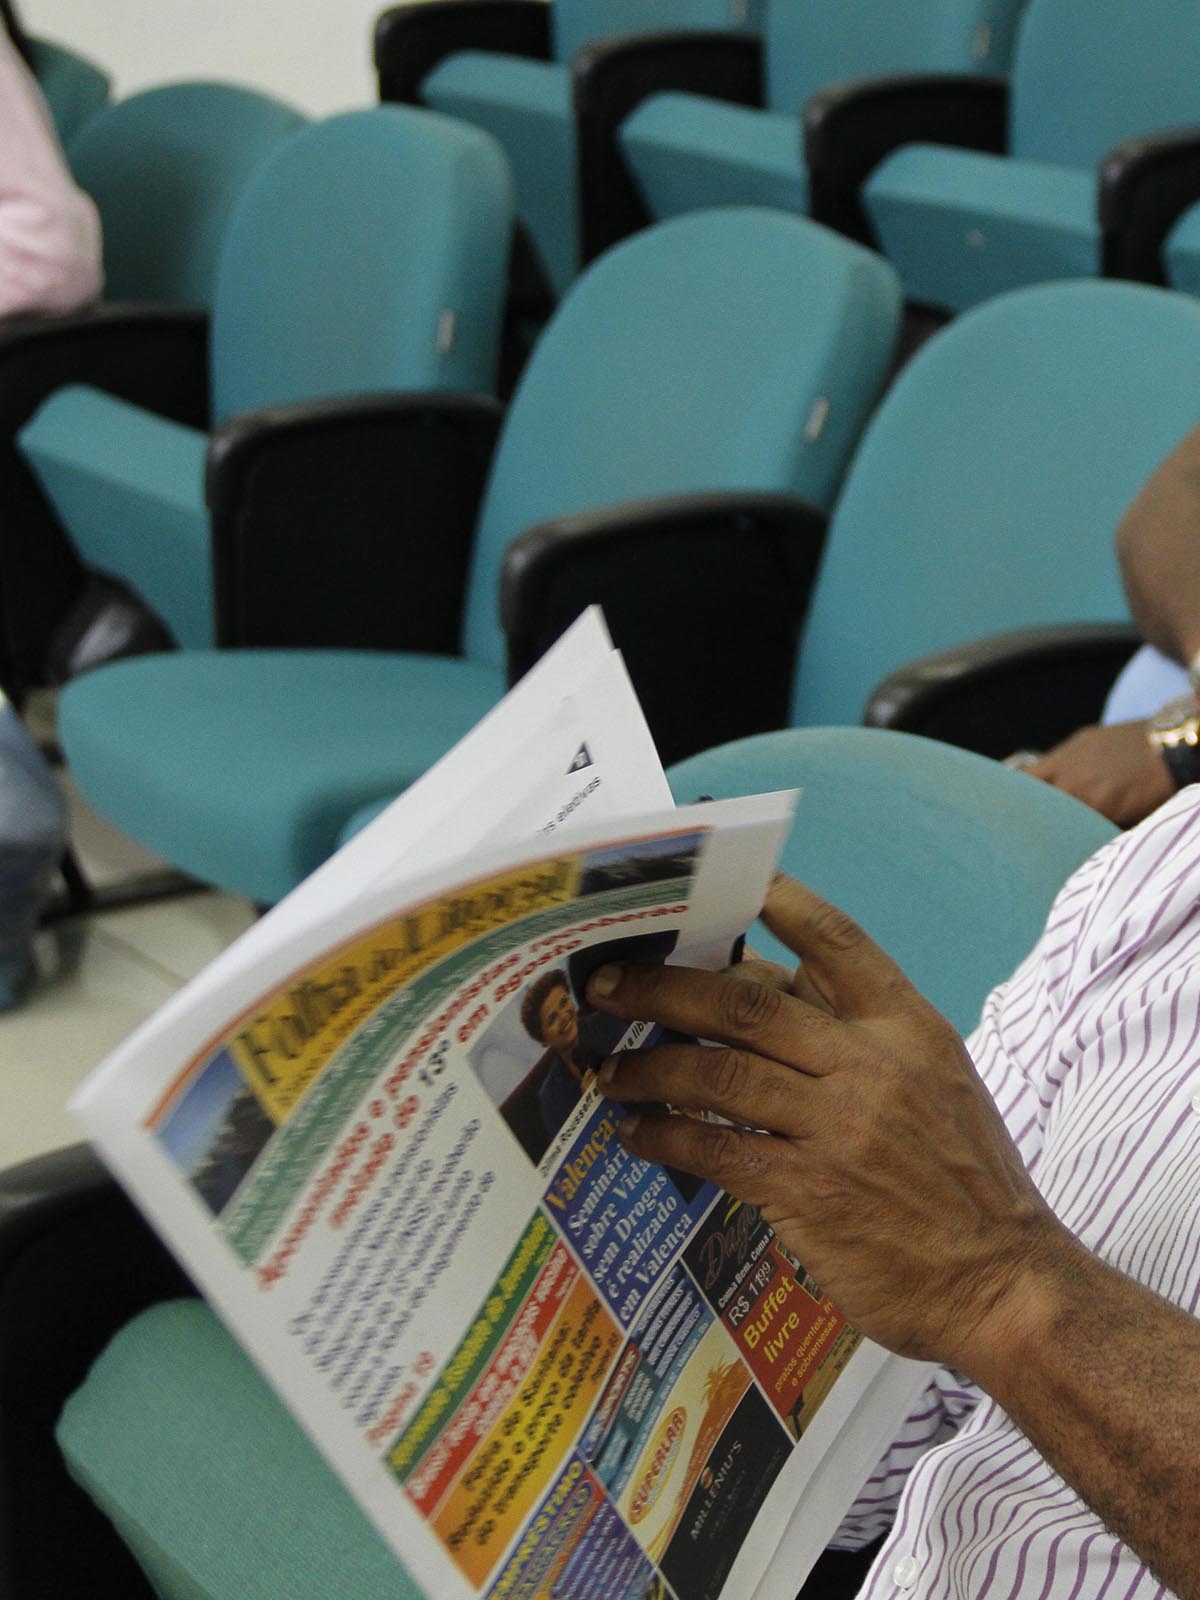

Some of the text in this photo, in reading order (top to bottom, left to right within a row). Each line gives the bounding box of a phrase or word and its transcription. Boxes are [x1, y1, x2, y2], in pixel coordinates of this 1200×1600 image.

[545, 1112, 623, 1211] Valença:
[566, 1145, 631, 1235] Seminári
[580, 1155, 652, 1259] sobre Vida
[590, 1171, 669, 1283] sem Drogas
[601, 1278, 620, 1299] é
[613, 1197, 678, 1283] realizado
[616, 1287, 641, 1321] em
[636, 1212, 694, 1285] Valença
[717, 1280, 739, 1308] Coma
[747, 1233, 770, 1261] Coma
[726, 1294, 753, 1326] R$
[742, 1273, 795, 1349] Buffet
[761, 1310, 801, 1363] livre
[795, 1314, 838, 1377] sobremesas
[772, 1356, 797, 1392] pratos
[630, 1412, 685, 1515] SUPERLAR
[689, 1439, 743, 1539] MILLENIU'S
